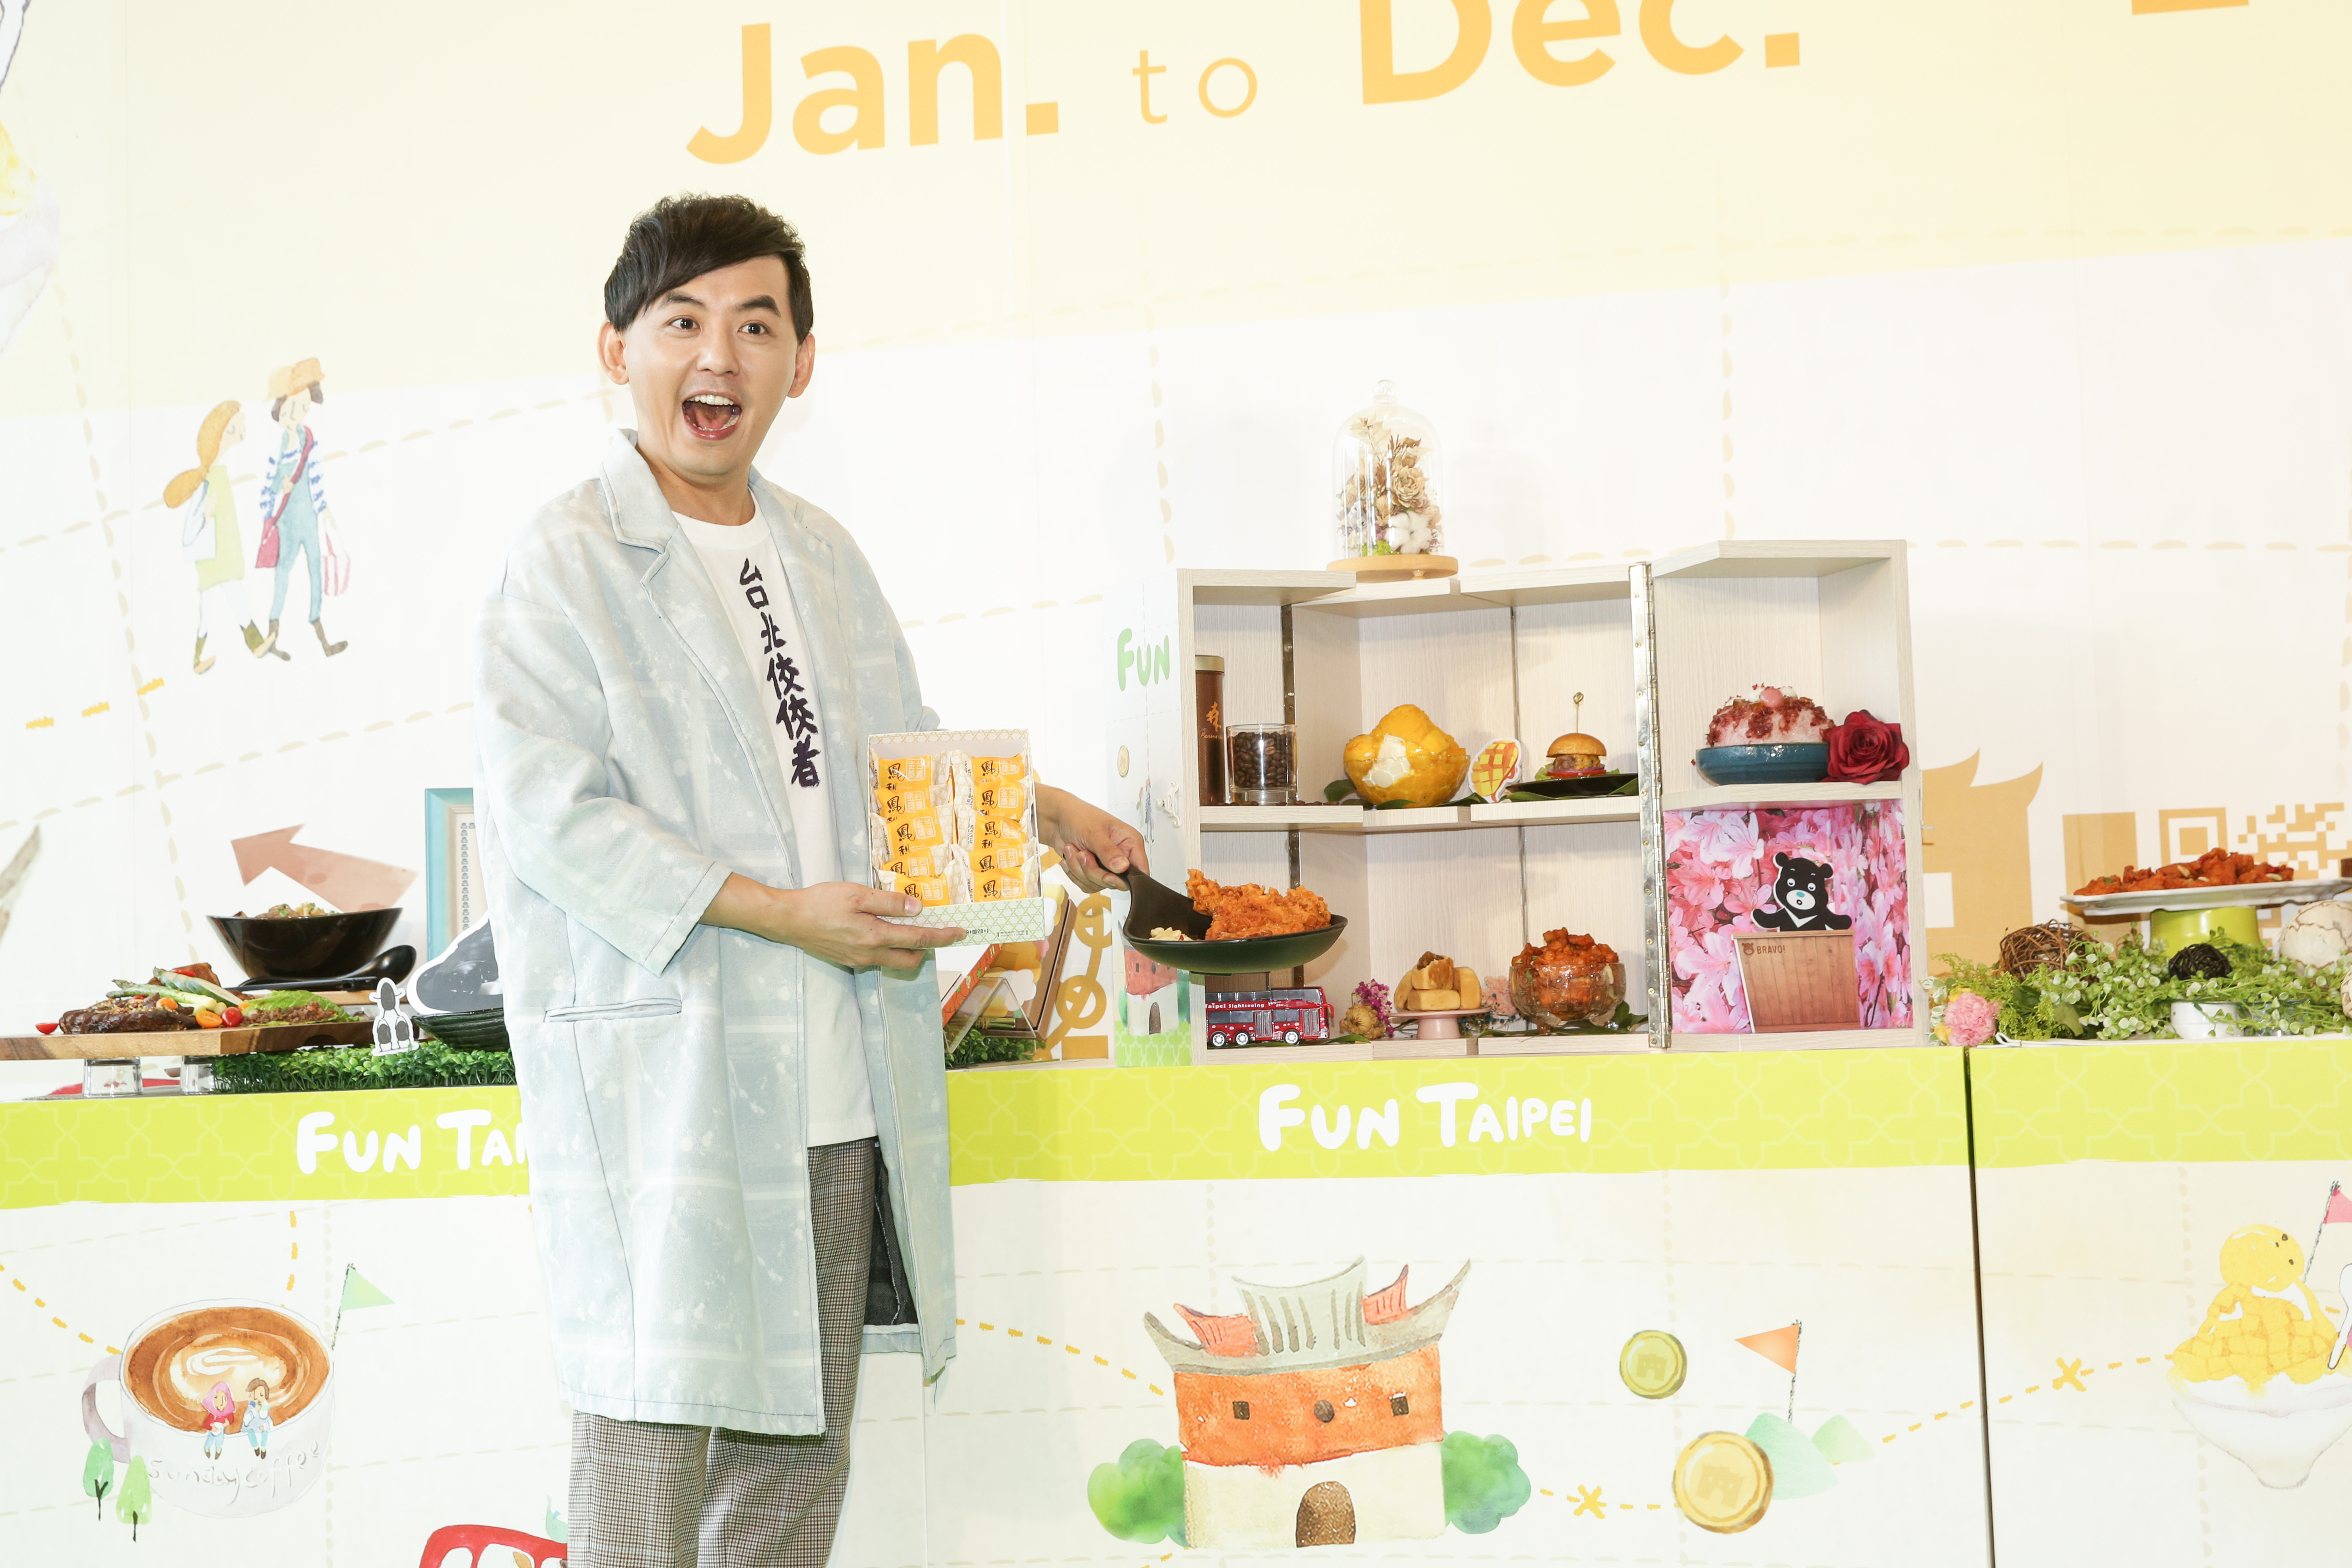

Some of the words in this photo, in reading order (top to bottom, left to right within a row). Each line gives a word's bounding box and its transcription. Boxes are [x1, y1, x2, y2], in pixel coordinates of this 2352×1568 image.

[686, 23, 1059, 165] Jan.
[1132, 50, 1257, 124] to
[1360, 0, 1801, 105] Dec.
[740, 558, 821, 788] 台北佼佼者
[1117, 628, 1170, 691] FUN
[1756, 945, 1786, 954] BRAVO!
[296, 1111, 422, 1175] FUN
[436, 1109, 527, 1171] TAI
[1258, 1084, 1400, 1152] FUN
[1415, 1082, 1593, 1147] TAIPEI
